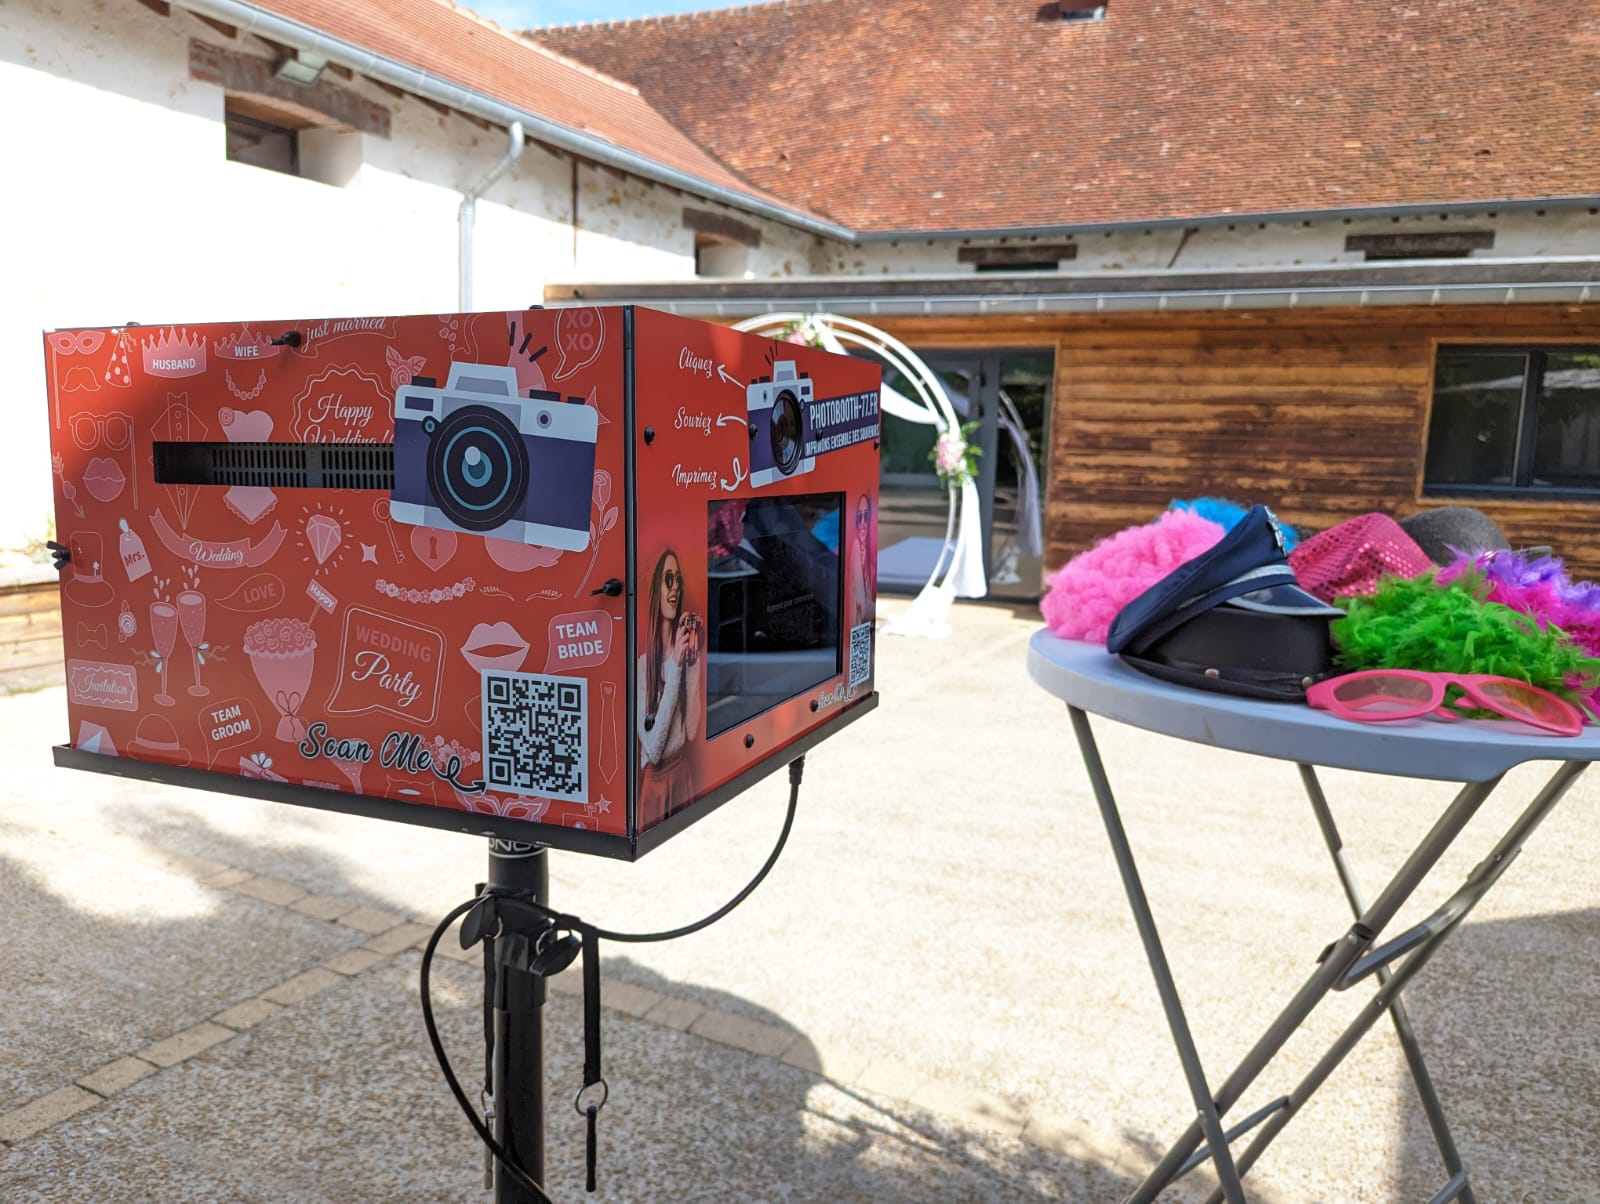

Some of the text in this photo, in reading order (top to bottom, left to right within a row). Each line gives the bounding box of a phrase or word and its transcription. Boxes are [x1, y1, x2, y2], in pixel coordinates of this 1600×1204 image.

[566, 310, 594, 328] XO
[301, 319, 329, 353] just
[566, 333, 594, 351] XO
[234, 345, 259, 357] WIFE
[679, 347, 713, 378] Cliquez
[152, 358, 196, 371] HUSBAND
[308, 393, 375, 427] Happy
[674, 406, 712, 437] Souriez
[810, 392, 878, 430] PHOTOBOOTH-77.FR
[671, 463, 718, 489] Imprimez
[124, 551, 145, 567] Mrs.
[189, 541, 245, 565] Wedding
[243, 583, 277, 604] LOVE
[309, 584, 335, 609] Happy
[555, 620, 598, 640] TEAM
[356, 623, 432, 663] WEDDING
[557, 639, 604, 660] BRIDE
[77, 673, 129, 696] Invitation
[351, 651, 423, 707] Party
[211, 704, 242, 724] TEAM
[211, 718, 251, 742] GROOM
[300, 722, 433, 774] Scan Me
